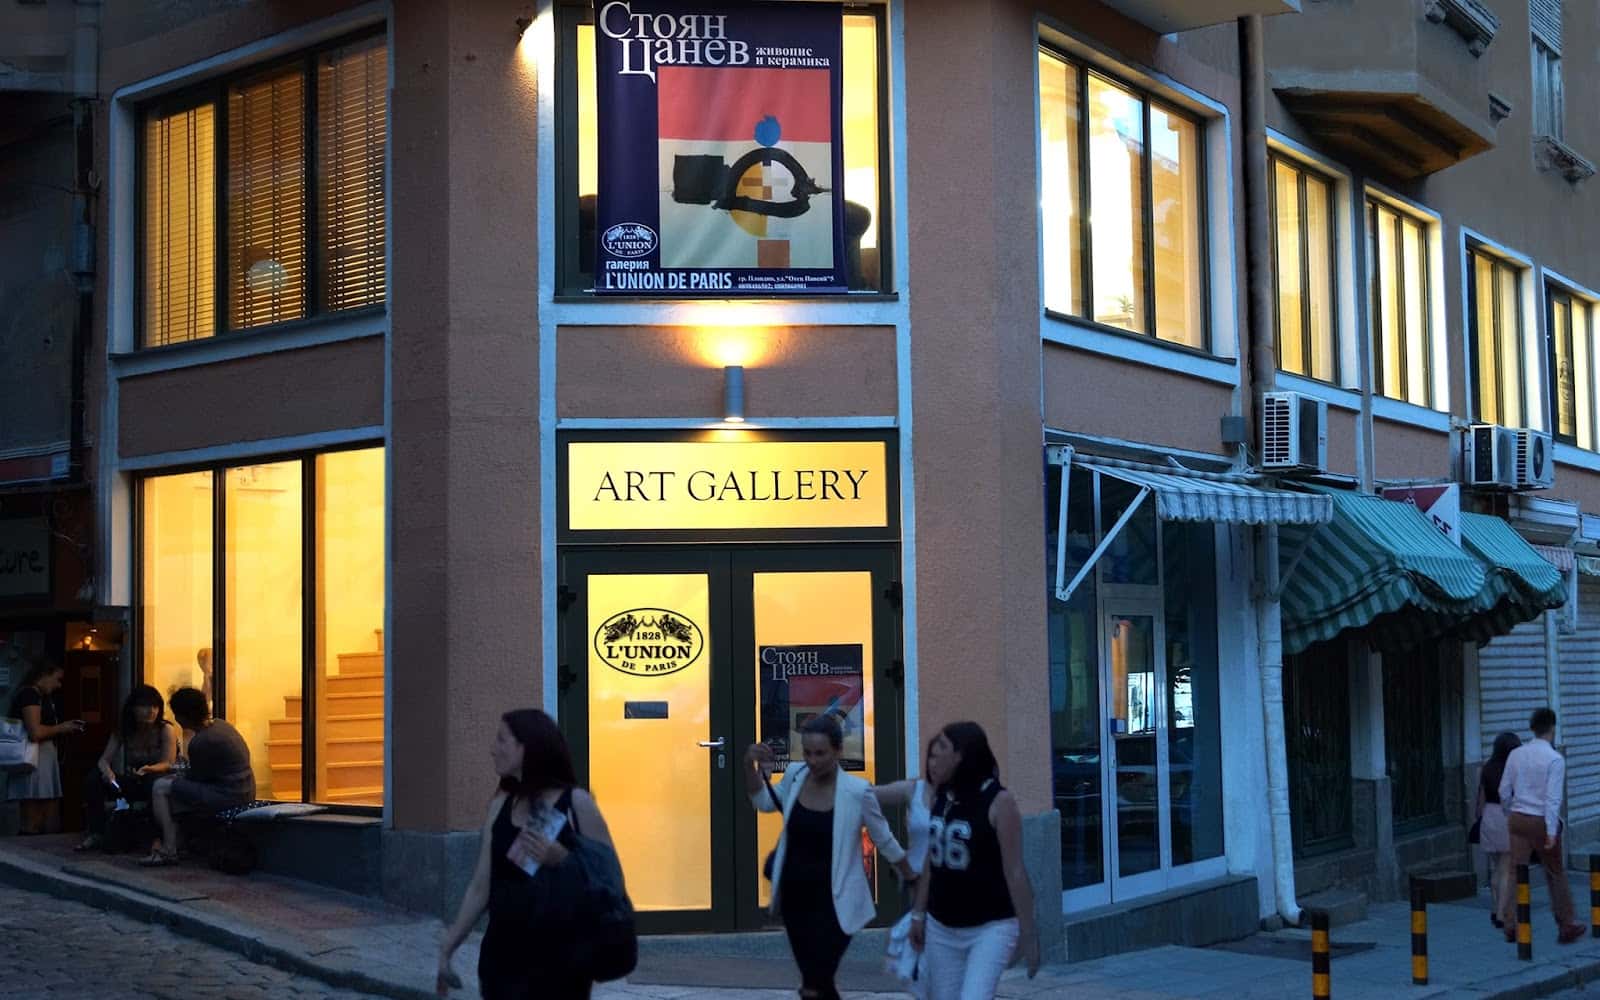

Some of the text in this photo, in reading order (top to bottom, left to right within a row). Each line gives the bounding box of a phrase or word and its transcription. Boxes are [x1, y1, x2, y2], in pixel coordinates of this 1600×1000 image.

[600, 1, 728, 40] Стоян
[618, 38, 750, 84] Цанев
[768, 57, 830, 69] керамика
[608, 241, 653, 249] L'UNION
[606, 260, 650, 272] галерия
[668, 272, 686, 289] DE
[690, 272, 732, 289] PARIS
[594, 470, 869, 502] ART GALLERY
[637, 631, 661, 641] 1828
[606, 645, 692, 659] L'UNION
[761, 647, 818, 664] Стоян
[622, 660, 678, 672] DE PARIS
[772, 662, 830, 684] Цанев
